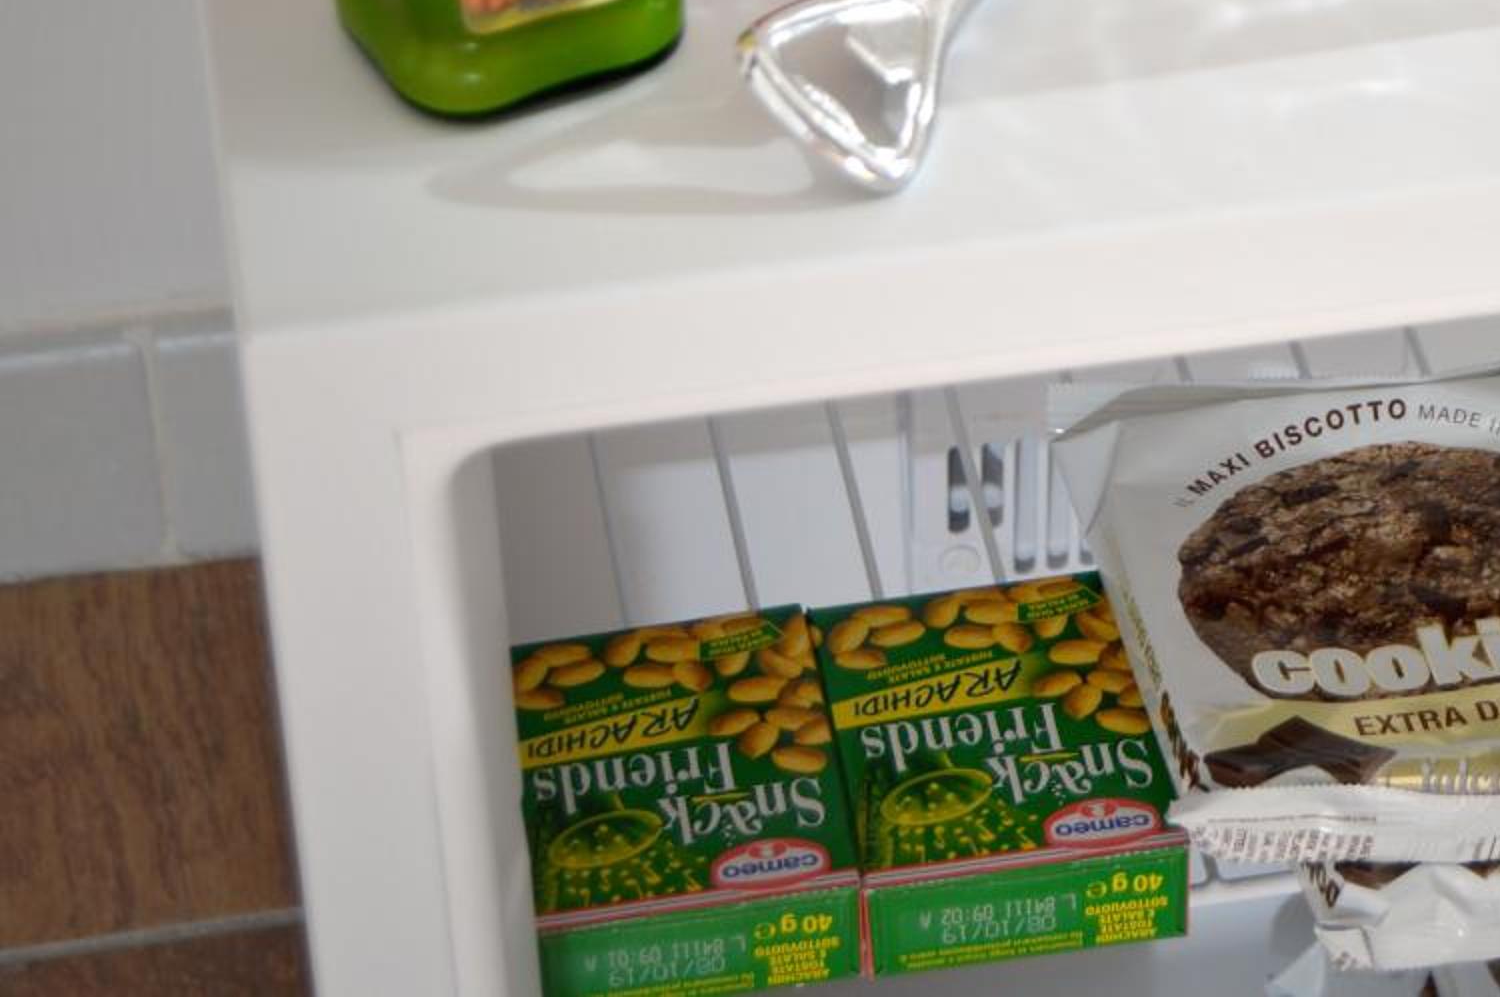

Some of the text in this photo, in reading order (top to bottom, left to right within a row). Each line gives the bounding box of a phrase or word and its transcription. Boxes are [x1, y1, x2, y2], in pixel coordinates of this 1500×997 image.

[1186, 451, 1252, 497] MAXI
[1253, 397, 1408, 461] BISCOTTO
[1417, 403, 1482, 429] MADE
[853, 658, 1023, 717] ARACHIDI
[526, 697, 701, 760] ARACHIDI
[859, 702, 1069, 772] Friends
[1353, 706, 1474, 738] EXTRA
[532, 742, 739, 816] Friends
[984, 738, 1154, 805] Snack
[656, 777, 826, 846] Snack
[1055, 810, 1150, 838] cameo
[722, 852, 819, 879] cameo
[1111, 871, 1164, 894] 40 g
[780, 913, 834, 934] 40 g
